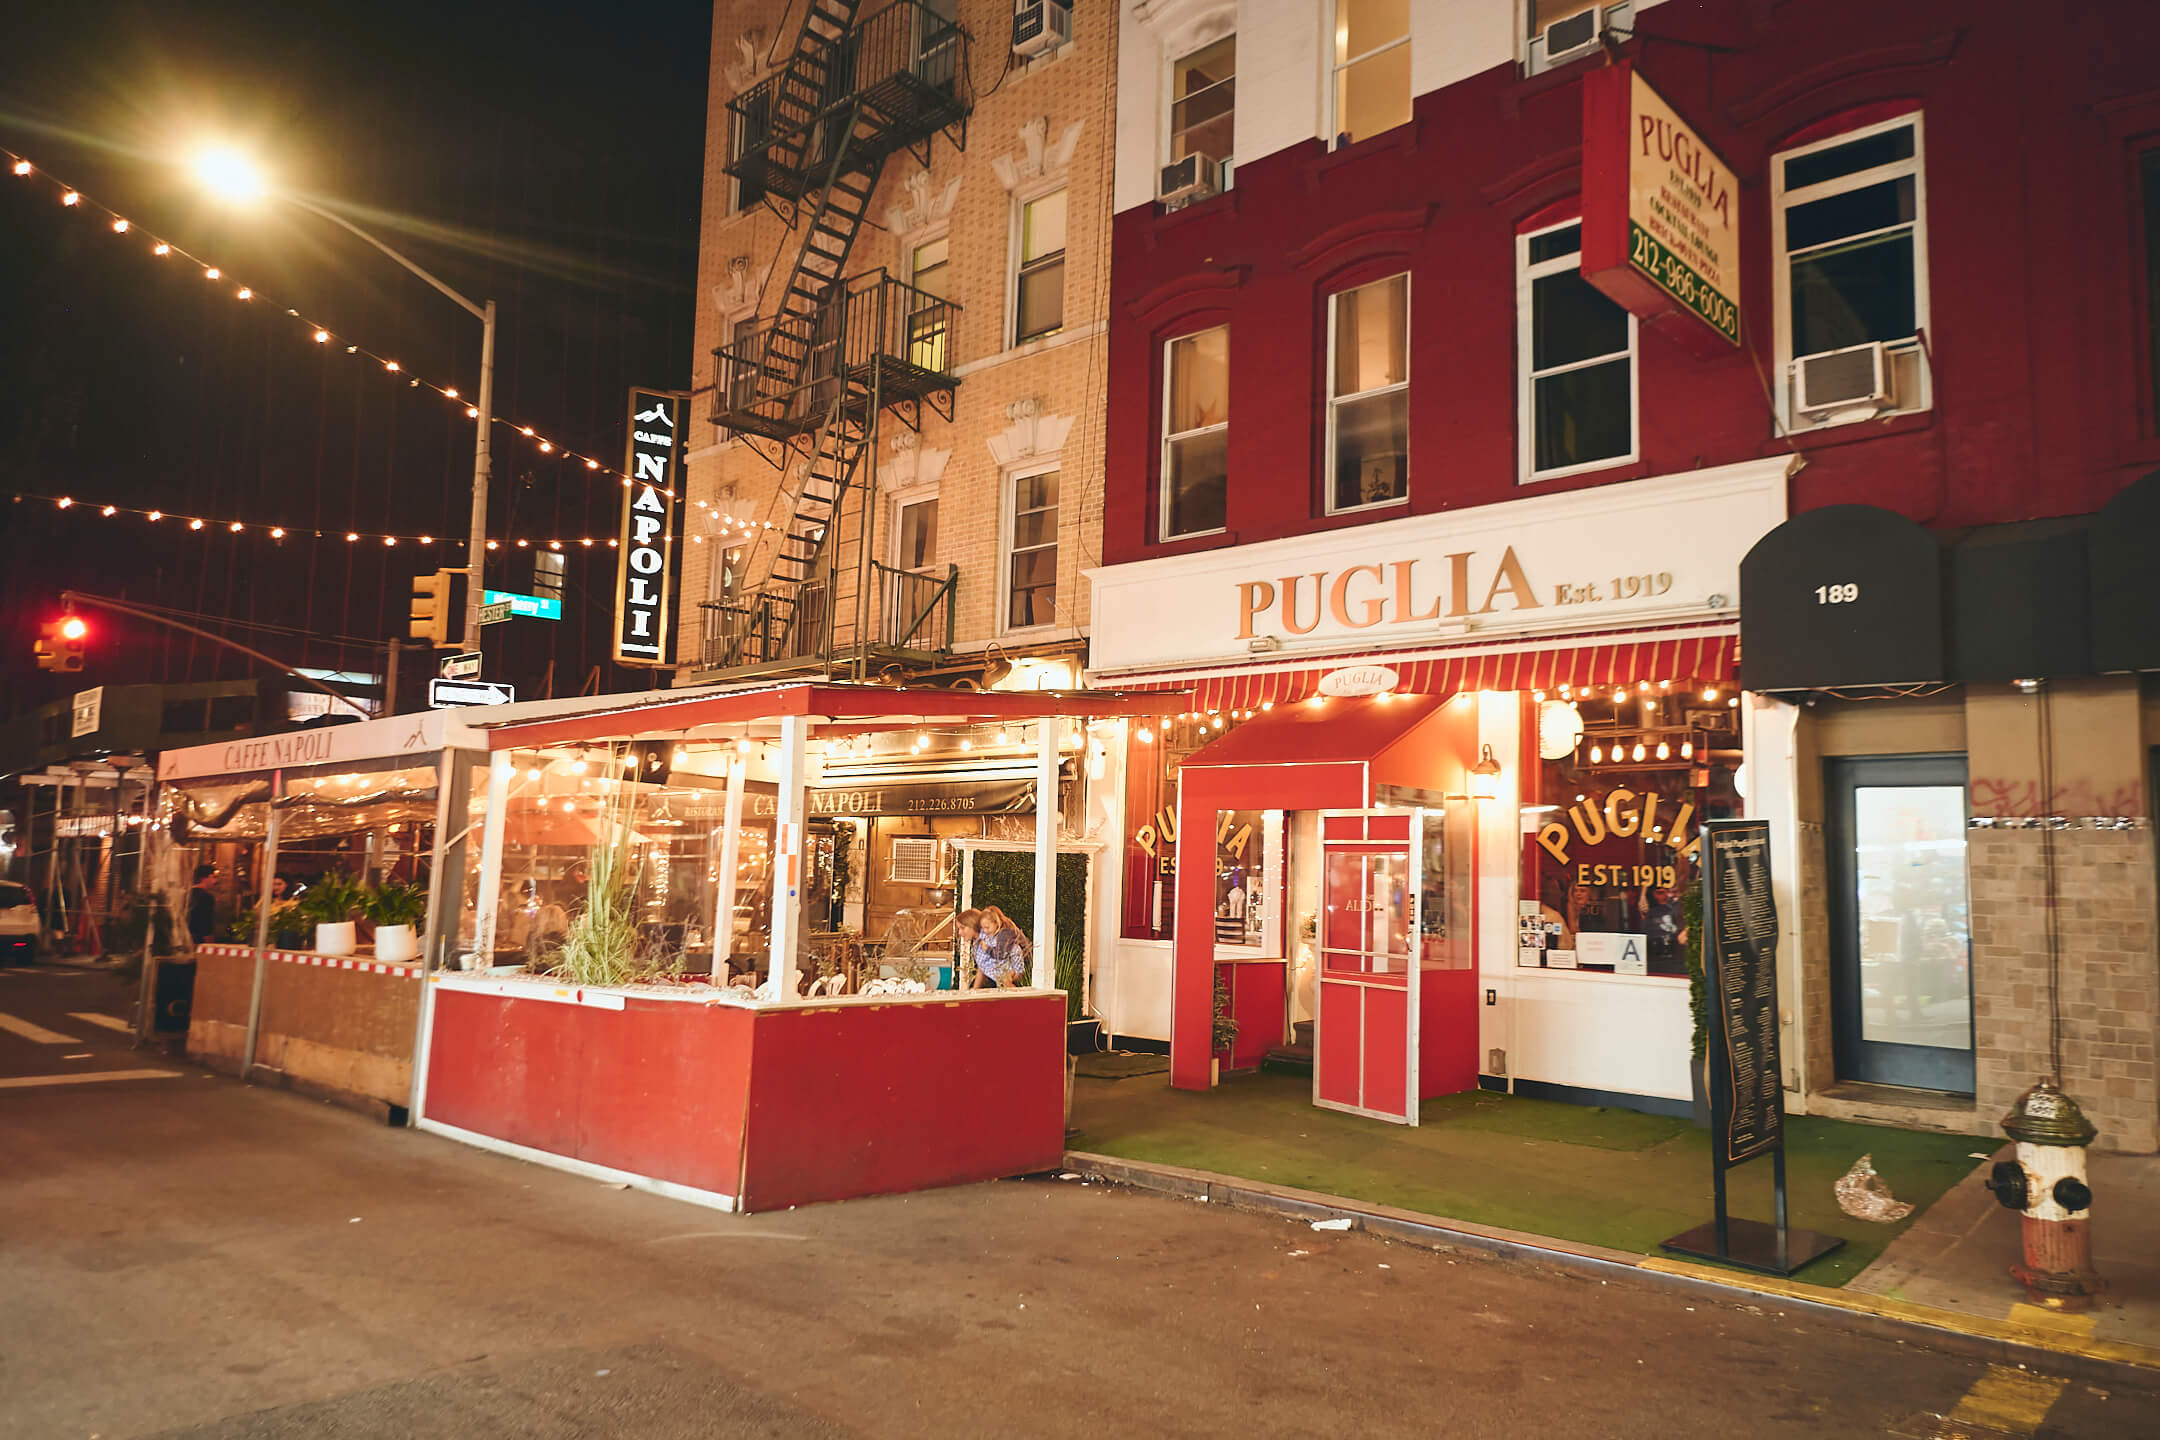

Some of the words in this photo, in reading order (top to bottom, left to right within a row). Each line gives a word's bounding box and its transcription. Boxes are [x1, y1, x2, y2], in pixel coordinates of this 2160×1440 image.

[1639, 114, 1729, 230] PUGLIA
[1632, 228, 1736, 336] 212-966-6006
[629, 452, 668, 637] NAPOLI
[1233, 545, 1544, 640] PUGLIA
[1553, 581, 1602, 606] Est.
[1609, 571, 1673, 601] 1919
[1815, 583, 1859, 605] 189
[1334, 671, 1384, 689] PUGLIA
[224, 742, 270, 770] CAFFE
[274, 732, 333, 764] NAPOLI
[810, 791, 883, 814] NAPOLI
[908, 797, 975, 811] 212.226.8705
[1632, 864, 1676, 889] 1919
[1622, 939, 1641, 961] A
